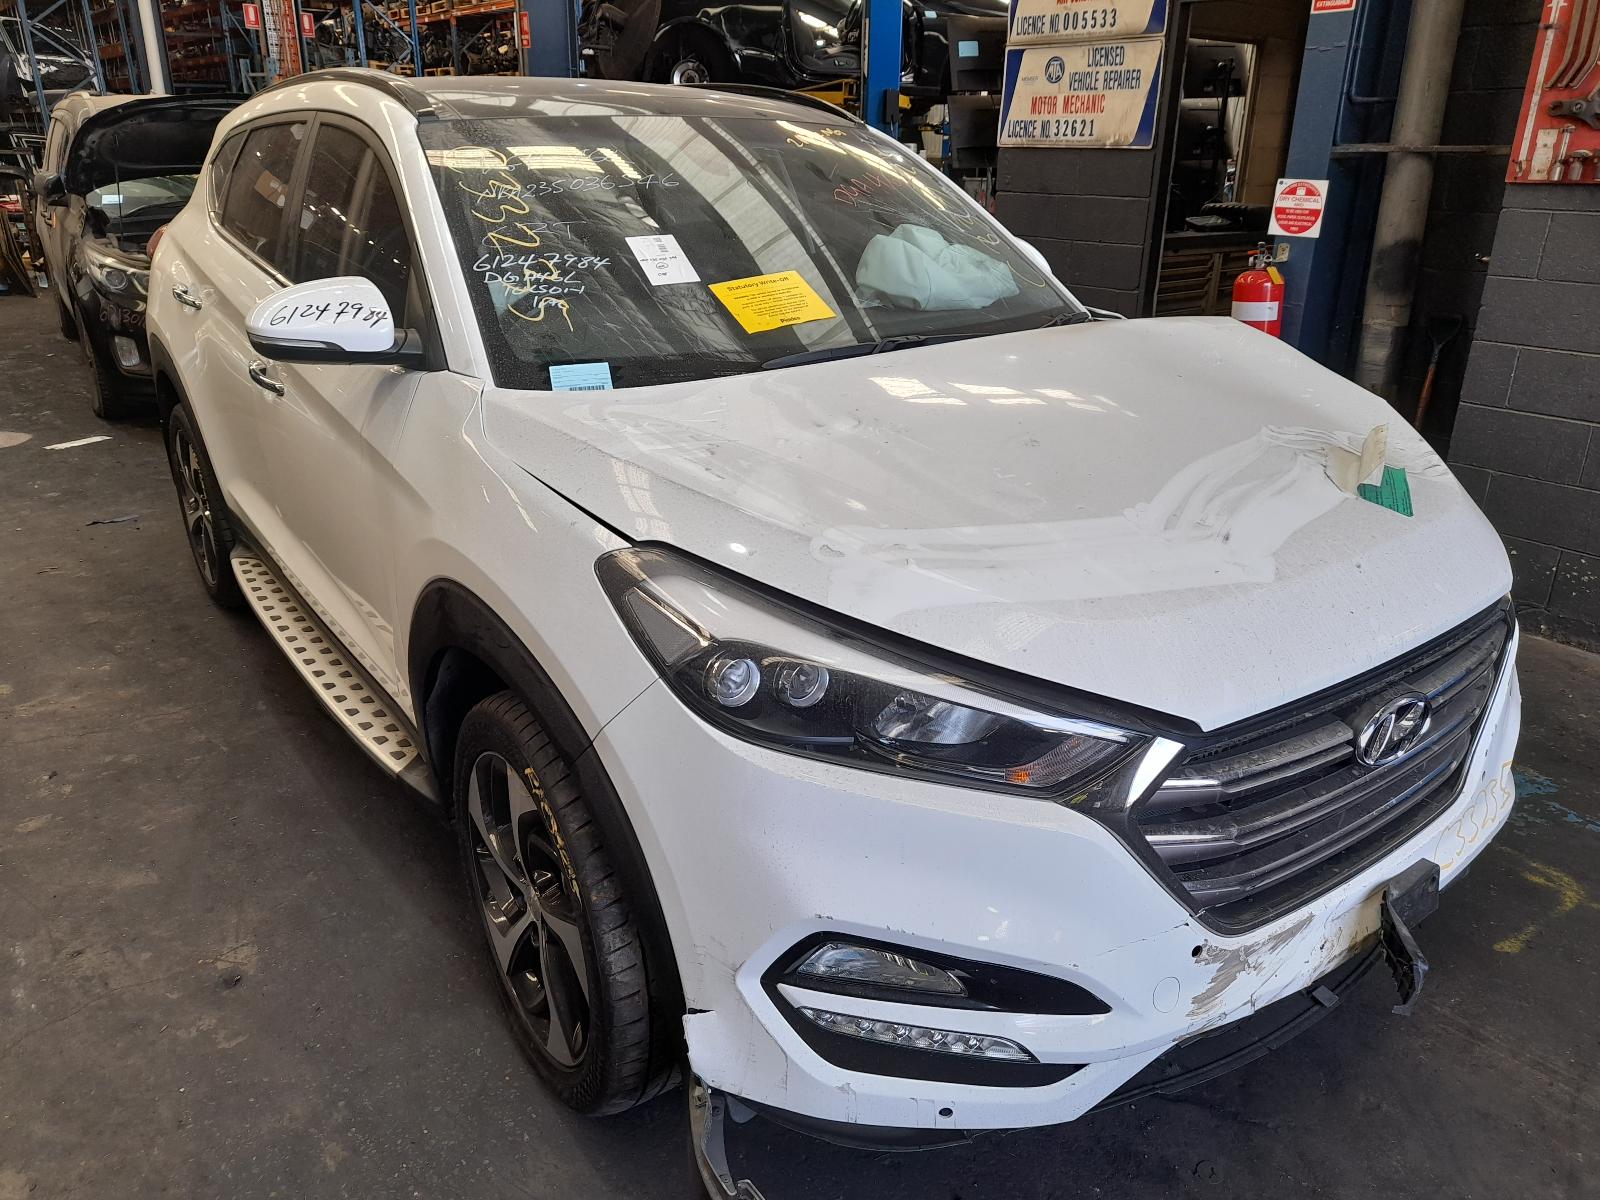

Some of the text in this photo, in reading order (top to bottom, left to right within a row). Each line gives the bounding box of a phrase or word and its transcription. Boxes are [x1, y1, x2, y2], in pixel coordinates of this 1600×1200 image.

[1016, 14, 1046, 36] LICENCE
[1063, 8, 1117, 30] 005533
[1087, 46, 1125, 67] LICENSED
[1069, 69, 1141, 91] VEHICLE REPAIRER
[1030, 94, 1106, 115] MOTOR MECHANIC
[1007, 119, 1037, 138] LICENCE
[1053, 119, 1095, 137] 32621
